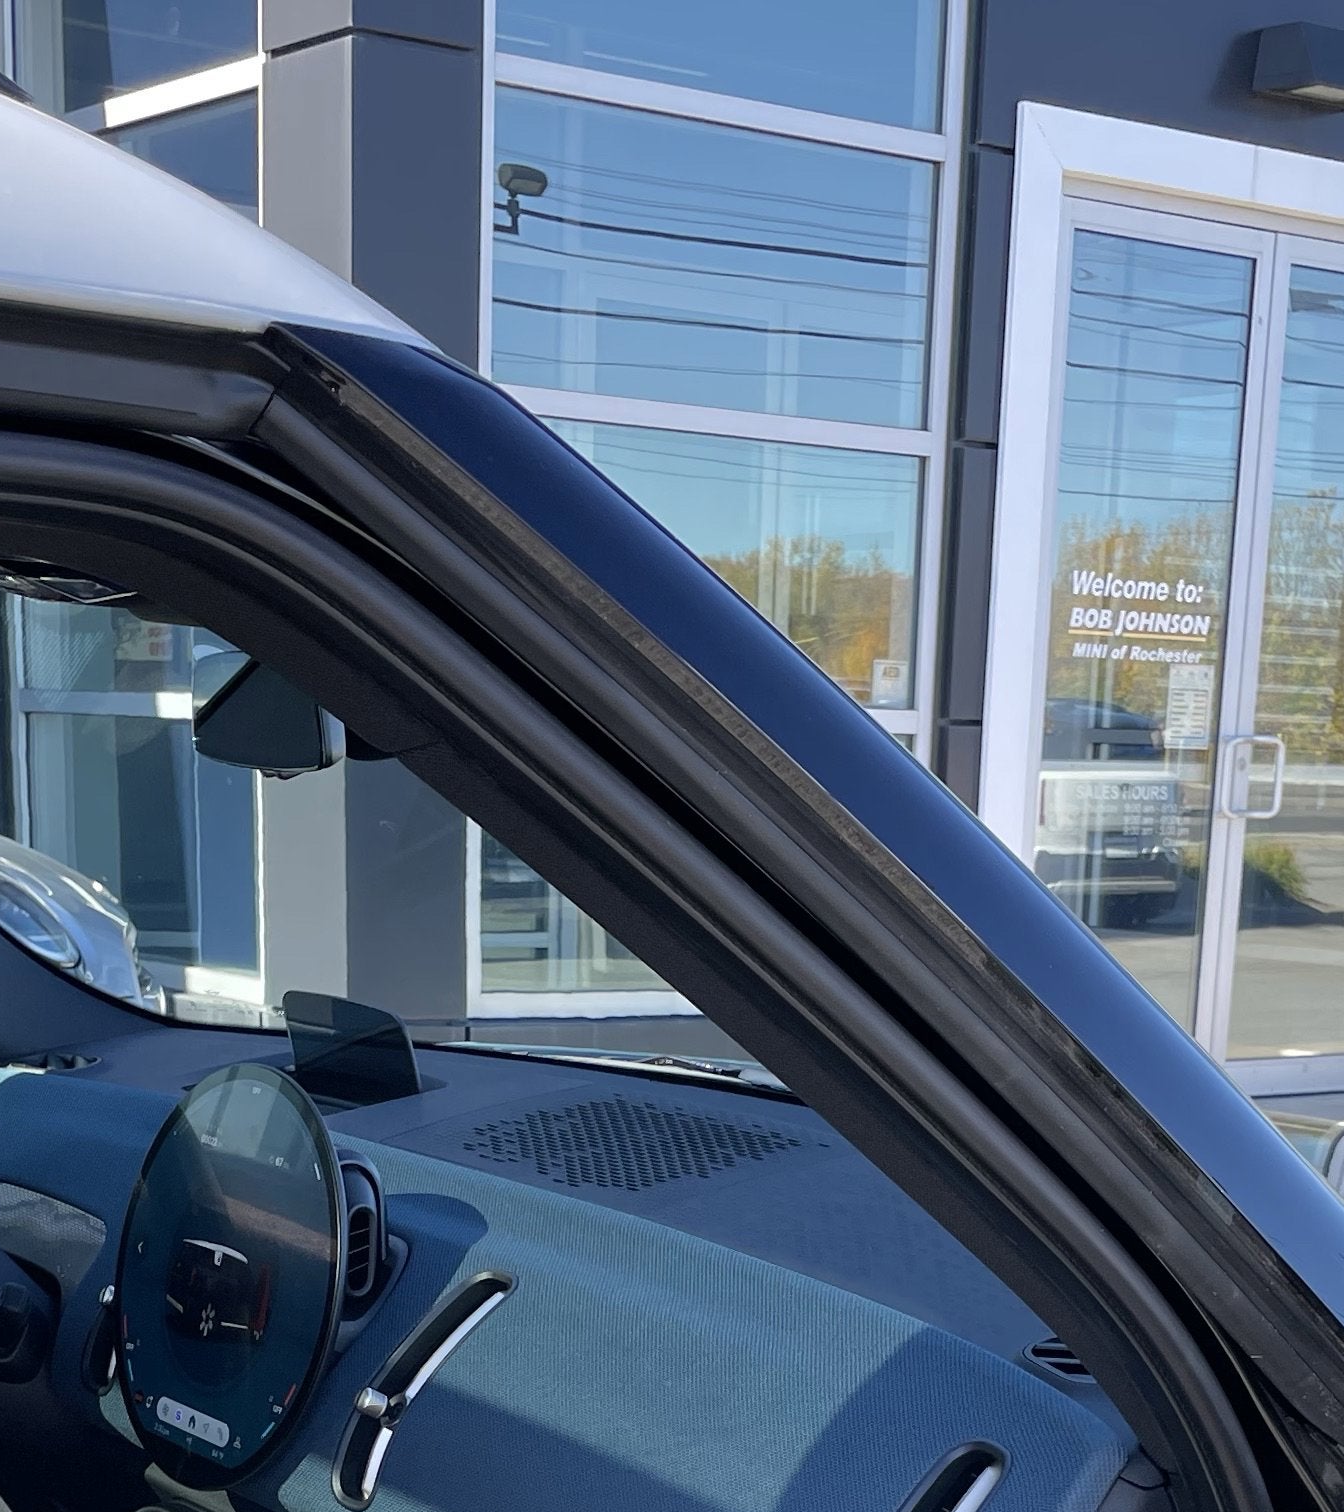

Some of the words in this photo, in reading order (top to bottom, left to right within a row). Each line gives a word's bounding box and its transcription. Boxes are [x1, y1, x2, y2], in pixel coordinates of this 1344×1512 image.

[1072, 570, 1169, 600] Welcome
[1176, 579, 1204, 603] to:
[1070, 607, 1113, 629] BOB
[1114, 610, 1211, 636] JOHNSON
[1072, 642, 1108, 659] MINI
[1111, 645, 1127, 660] of
[1130, 646, 1202, 664] Rochester
[1076, 785, 1119, 800] SALES
[1122, 784, 1169, 801] HOURS
